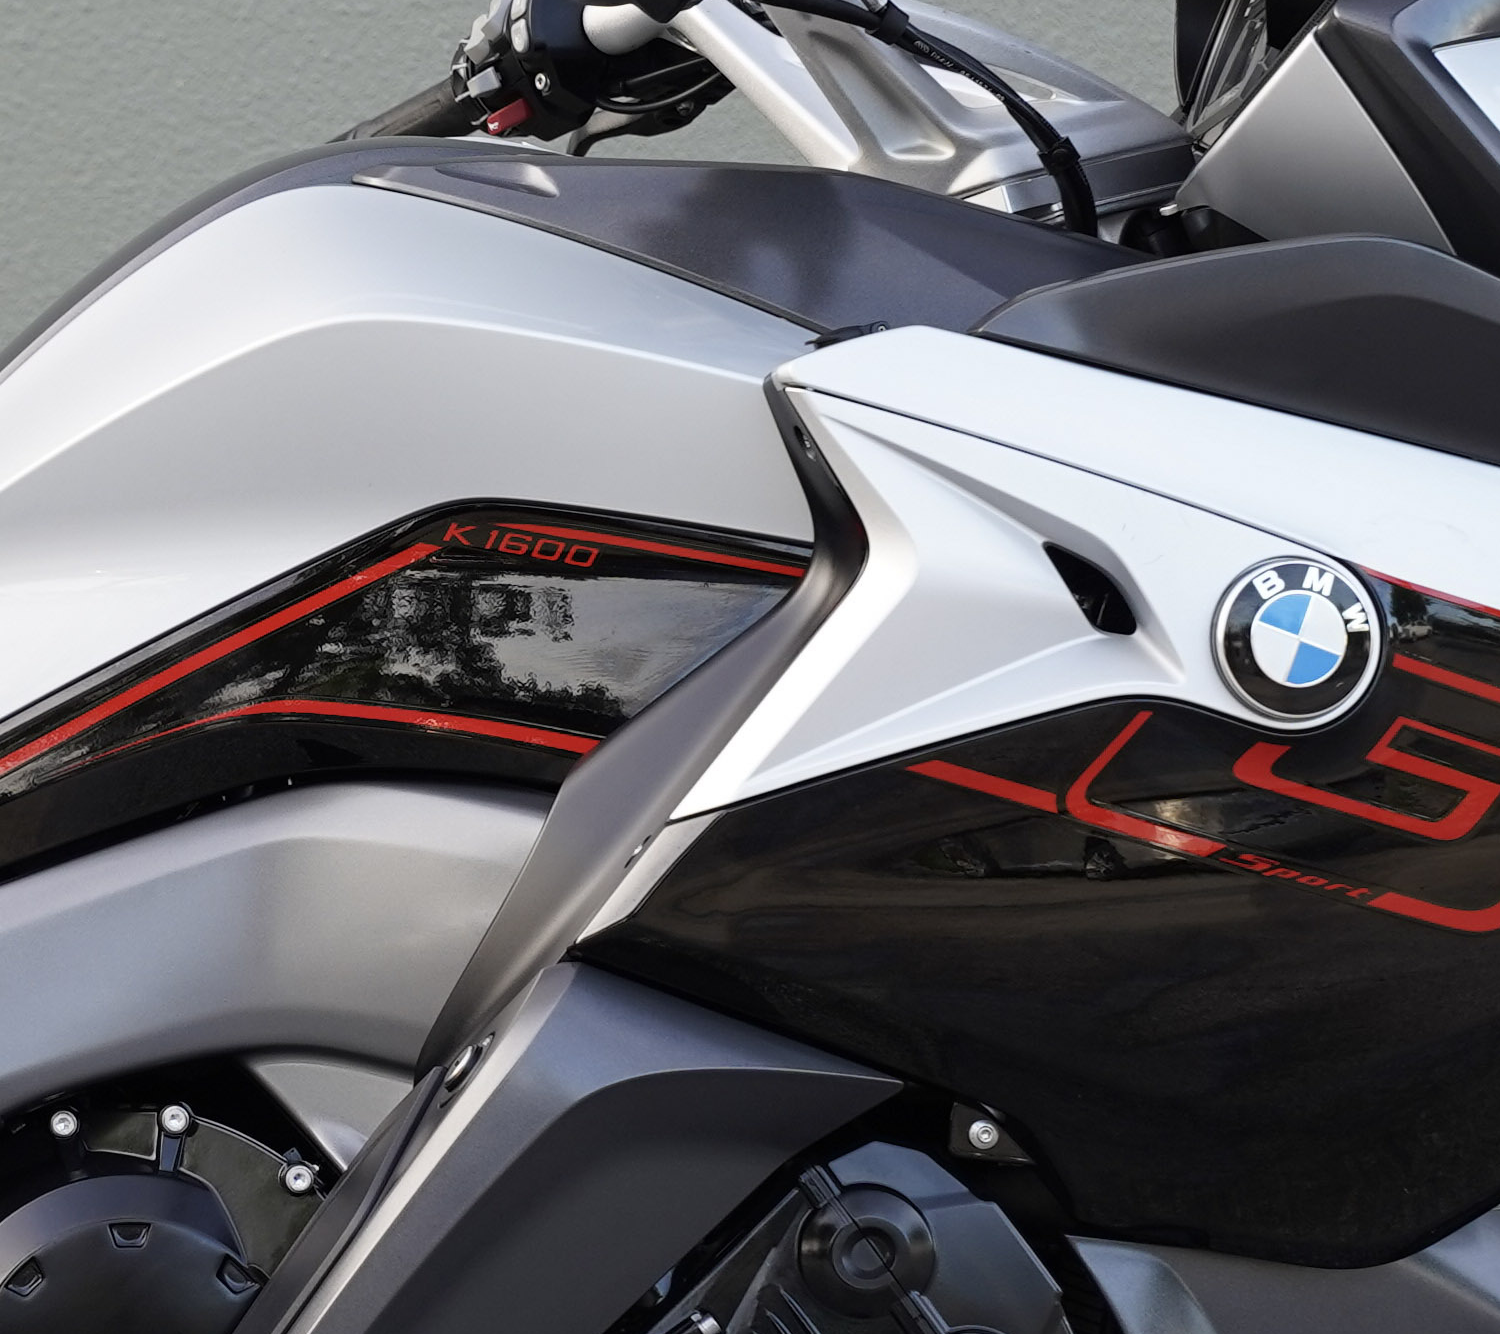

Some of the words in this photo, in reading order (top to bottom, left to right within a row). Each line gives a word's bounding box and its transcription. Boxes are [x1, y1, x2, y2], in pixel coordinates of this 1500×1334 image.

[443, 522, 476, 546] K
[485, 530, 600, 568] 1600
[1252, 566, 1370, 633] BMW
[1218, 853, 1373, 899] Sport
